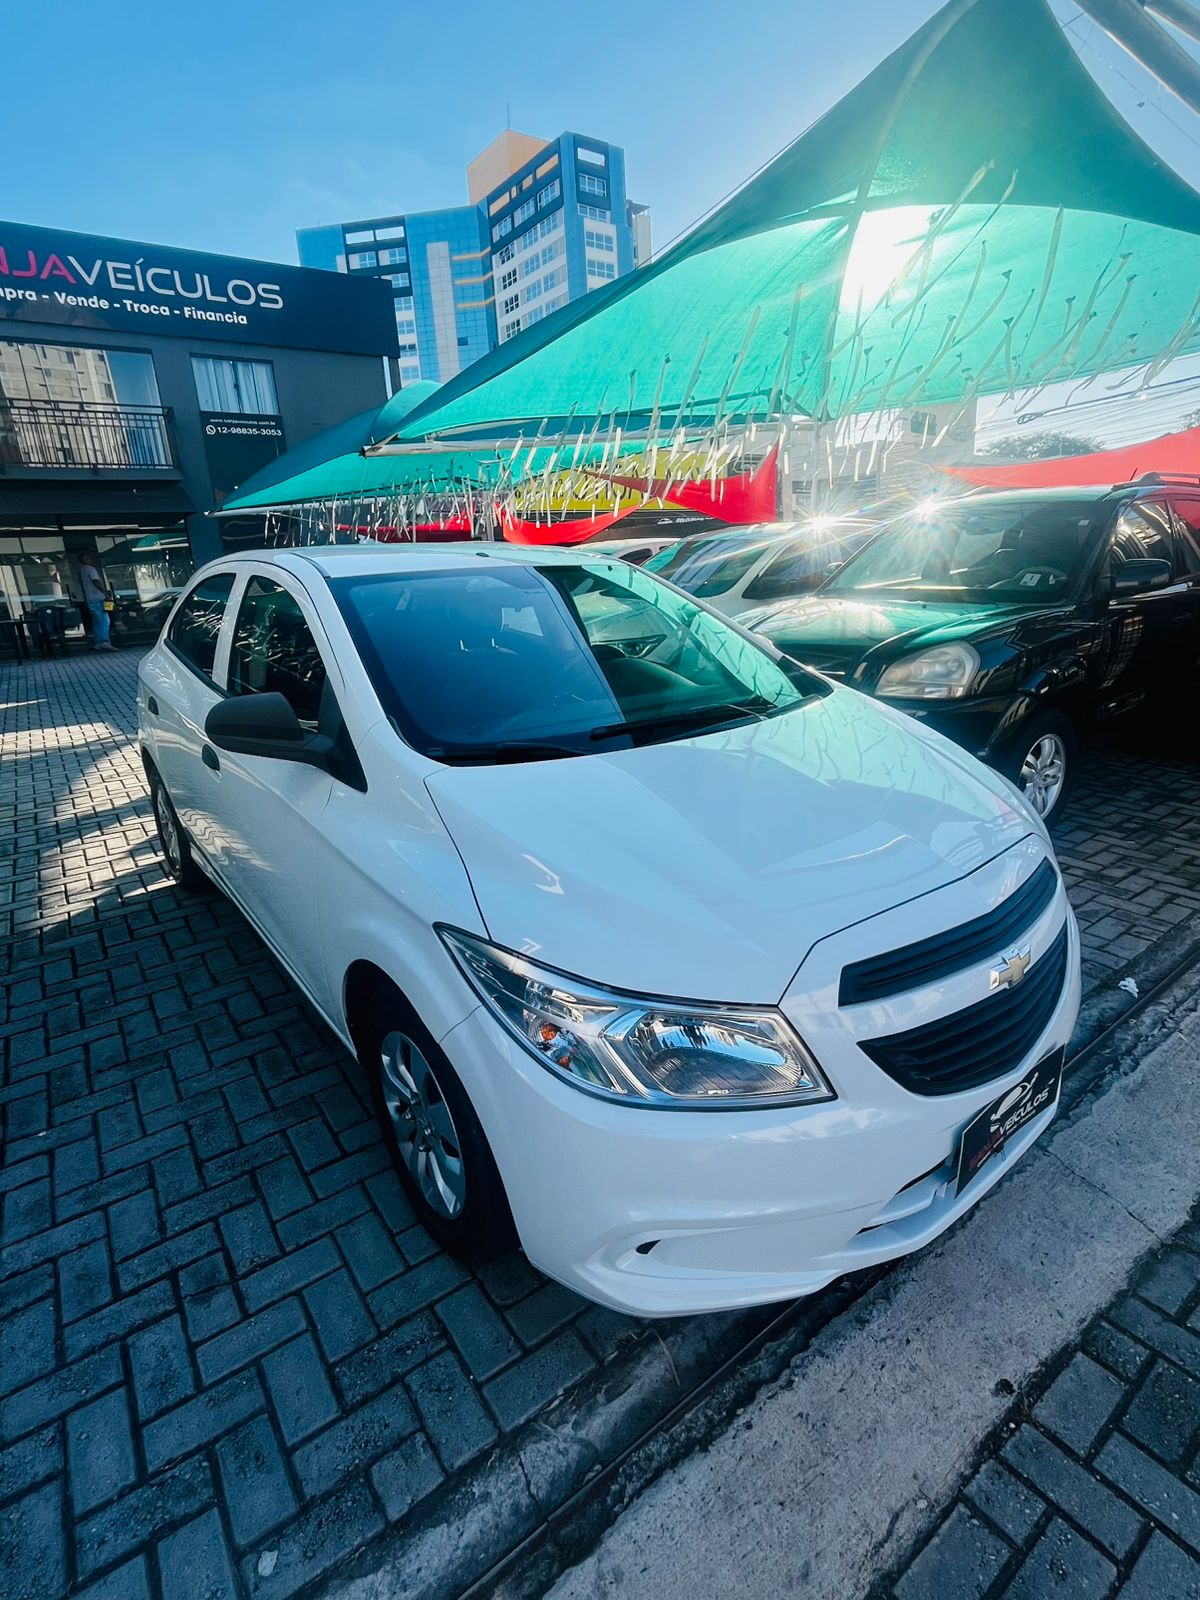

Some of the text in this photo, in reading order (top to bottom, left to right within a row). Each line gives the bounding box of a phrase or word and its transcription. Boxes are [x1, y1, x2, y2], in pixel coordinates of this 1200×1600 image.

[0, 287, 38, 301] pra
[54, 291, 110, 309] Vende
[123, 299, 170, 316] Troca
[183, 306, 248, 325] Financia
[217, 426, 282, 436] 12-98835-3053
